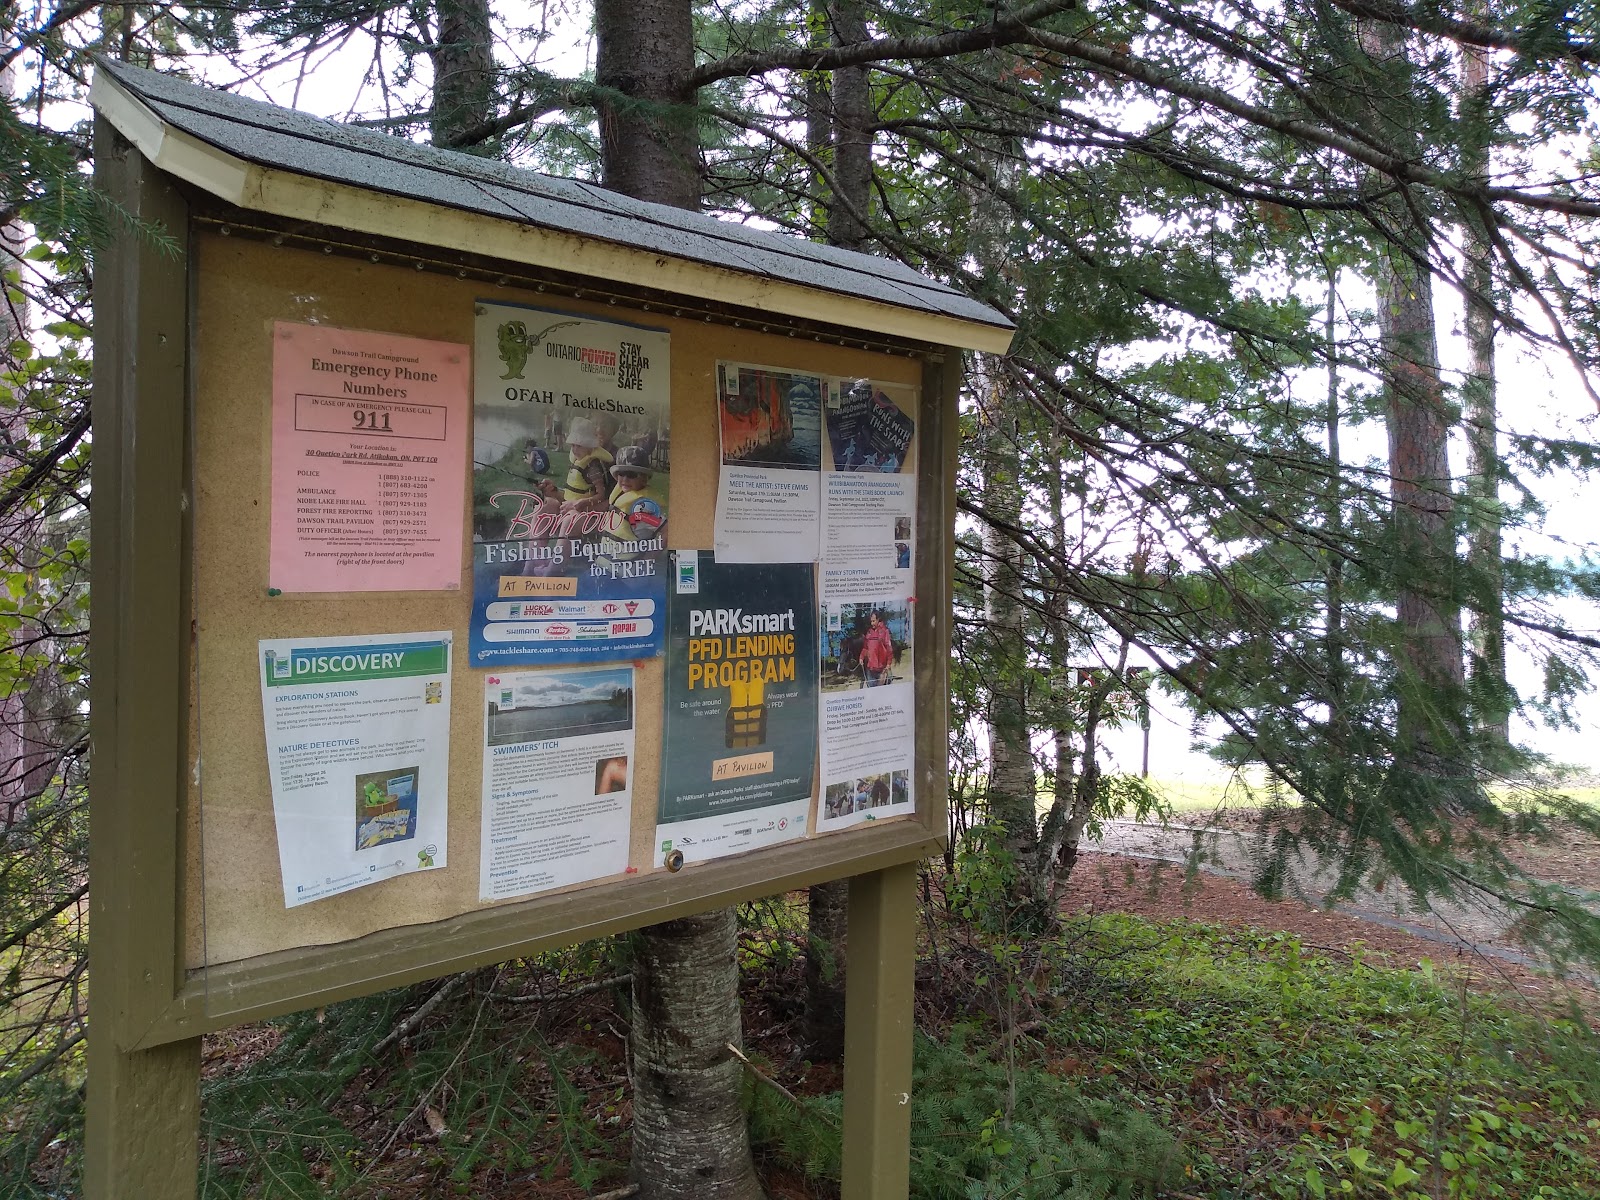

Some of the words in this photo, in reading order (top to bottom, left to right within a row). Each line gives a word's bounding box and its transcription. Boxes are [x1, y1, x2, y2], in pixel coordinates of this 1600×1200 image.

[332, 348, 359, 357] Dawson
[360, 350, 377, 359] Trail
[377, 352, 419, 364] Campground
[620, 341, 642, 356] STAY
[580, 362, 616, 376] GENERATION
[619, 354, 650, 370] CLEAR
[311, 358, 390, 380] Emergency
[394, 367, 438, 382] Phone
[618, 366, 642, 379] STAY
[343, 380, 407, 398] Numbers
[617, 377, 643, 391] SAFE
[356, 403, 392, 411] EMERGENCY
[505, 387, 553, 404] OFAH
[562, 392, 645, 415] TackleShare
[353, 410, 392, 429] 911
[872, 403, 892, 424] RUNS
[891, 420, 911, 441] WITH
[869, 414, 884, 432] THE
[883, 427, 906, 451] STARS
[791, 483, 809, 491] EMMS
[489, 490, 626, 541] Borrow
[484, 541, 564, 565] Fishing
[570, 534, 663, 562] Equipment
[590, 564, 609, 577] for
[610, 558, 656, 580] FREE
[504, 582, 517, 592] AT
[525, 581, 571, 591] PAVILION
[558, 605, 586, 613] Walmart
[689, 608, 795, 636] PARKsmart
[688, 637, 723, 661] PFD
[726, 633, 795, 659] LENDING
[296, 652, 405, 675] DISCOVERY
[688, 656, 795, 690] PROGRAM
[275, 692, 324, 703] EXPLORATION
[325, 690, 359, 699] STATIONS
[689, 700, 701, 708] safe
[701, 698, 722, 707] around
[767, 692, 785, 701] Always
[704, 708, 720, 716] water
[278, 743, 308, 753] NATURE
[310, 738, 360, 749] DETECTIVES
[542, 741, 559, 749] ITCH
[716, 764, 728, 775] AT
[732, 760, 768, 772] PAVILION
[512, 788, 539, 797] Symptoms
[682, 793, 705, 802] PARKsmart
[490, 835, 518, 844] Treatment
[489, 869, 518, 878] Prevention
